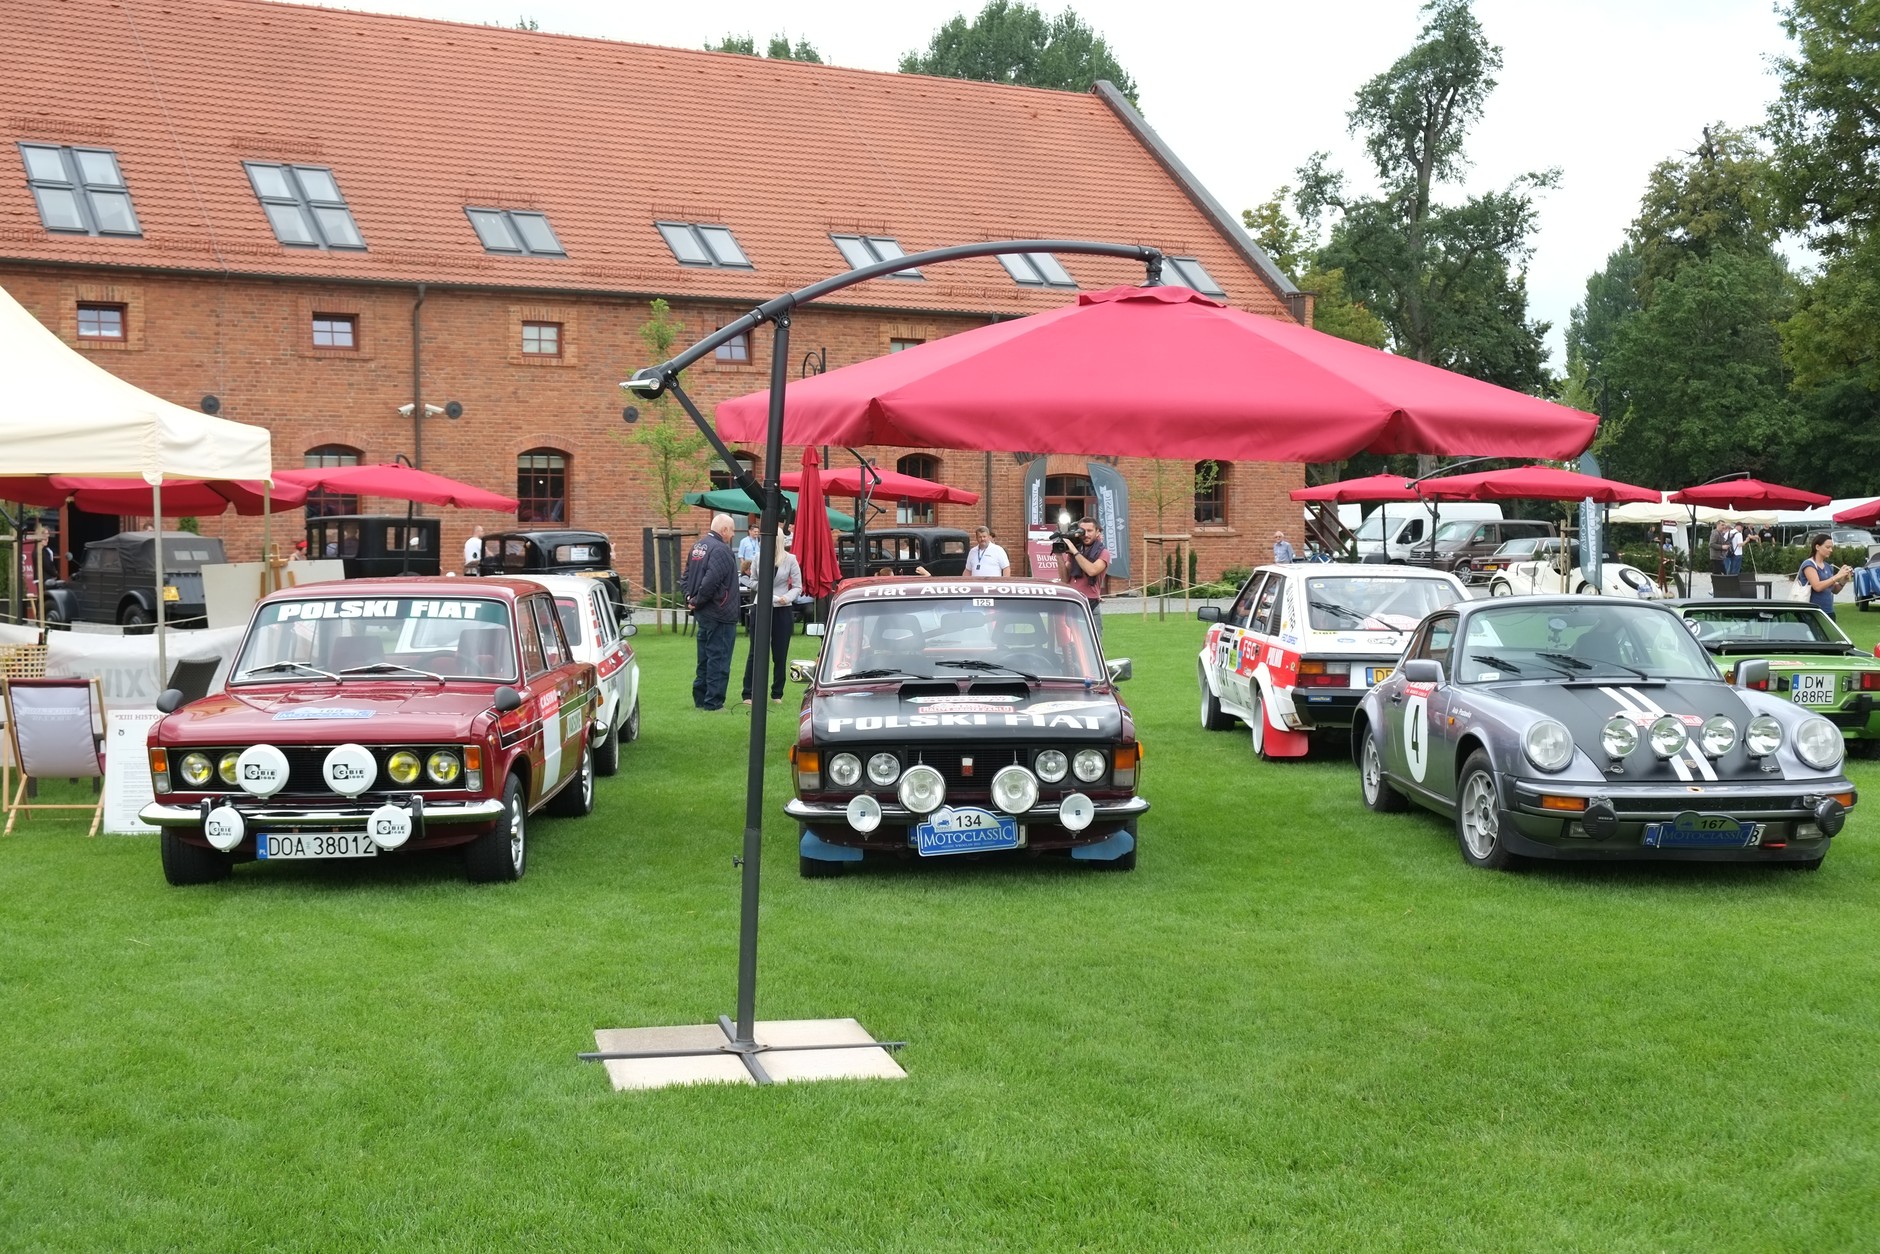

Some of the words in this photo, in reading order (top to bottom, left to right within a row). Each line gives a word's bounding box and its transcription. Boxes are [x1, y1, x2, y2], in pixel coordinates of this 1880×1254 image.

[920, 584, 971, 595] Auto
[983, 585, 1058, 595] Poland
[277, 600, 399, 622] POLSKI
[410, 600, 482, 619] FIAT
[1805, 676, 1824, 689] DW
[1793, 690, 1832, 703] 688RE
[828, 714, 987, 732] POLSKI
[1005, 714, 1105, 730] FIAT
[1411, 705, 1419, 763] 4
[956, 814, 982, 828] 134
[1701, 819, 1727, 829] 167
[923, 826, 1012, 848] MOTOCLASSIC
[1661, 829, 1751, 841] MOTOCLASSIC
[268, 837, 306, 856] DOA
[313, 835, 374, 855] 38012
